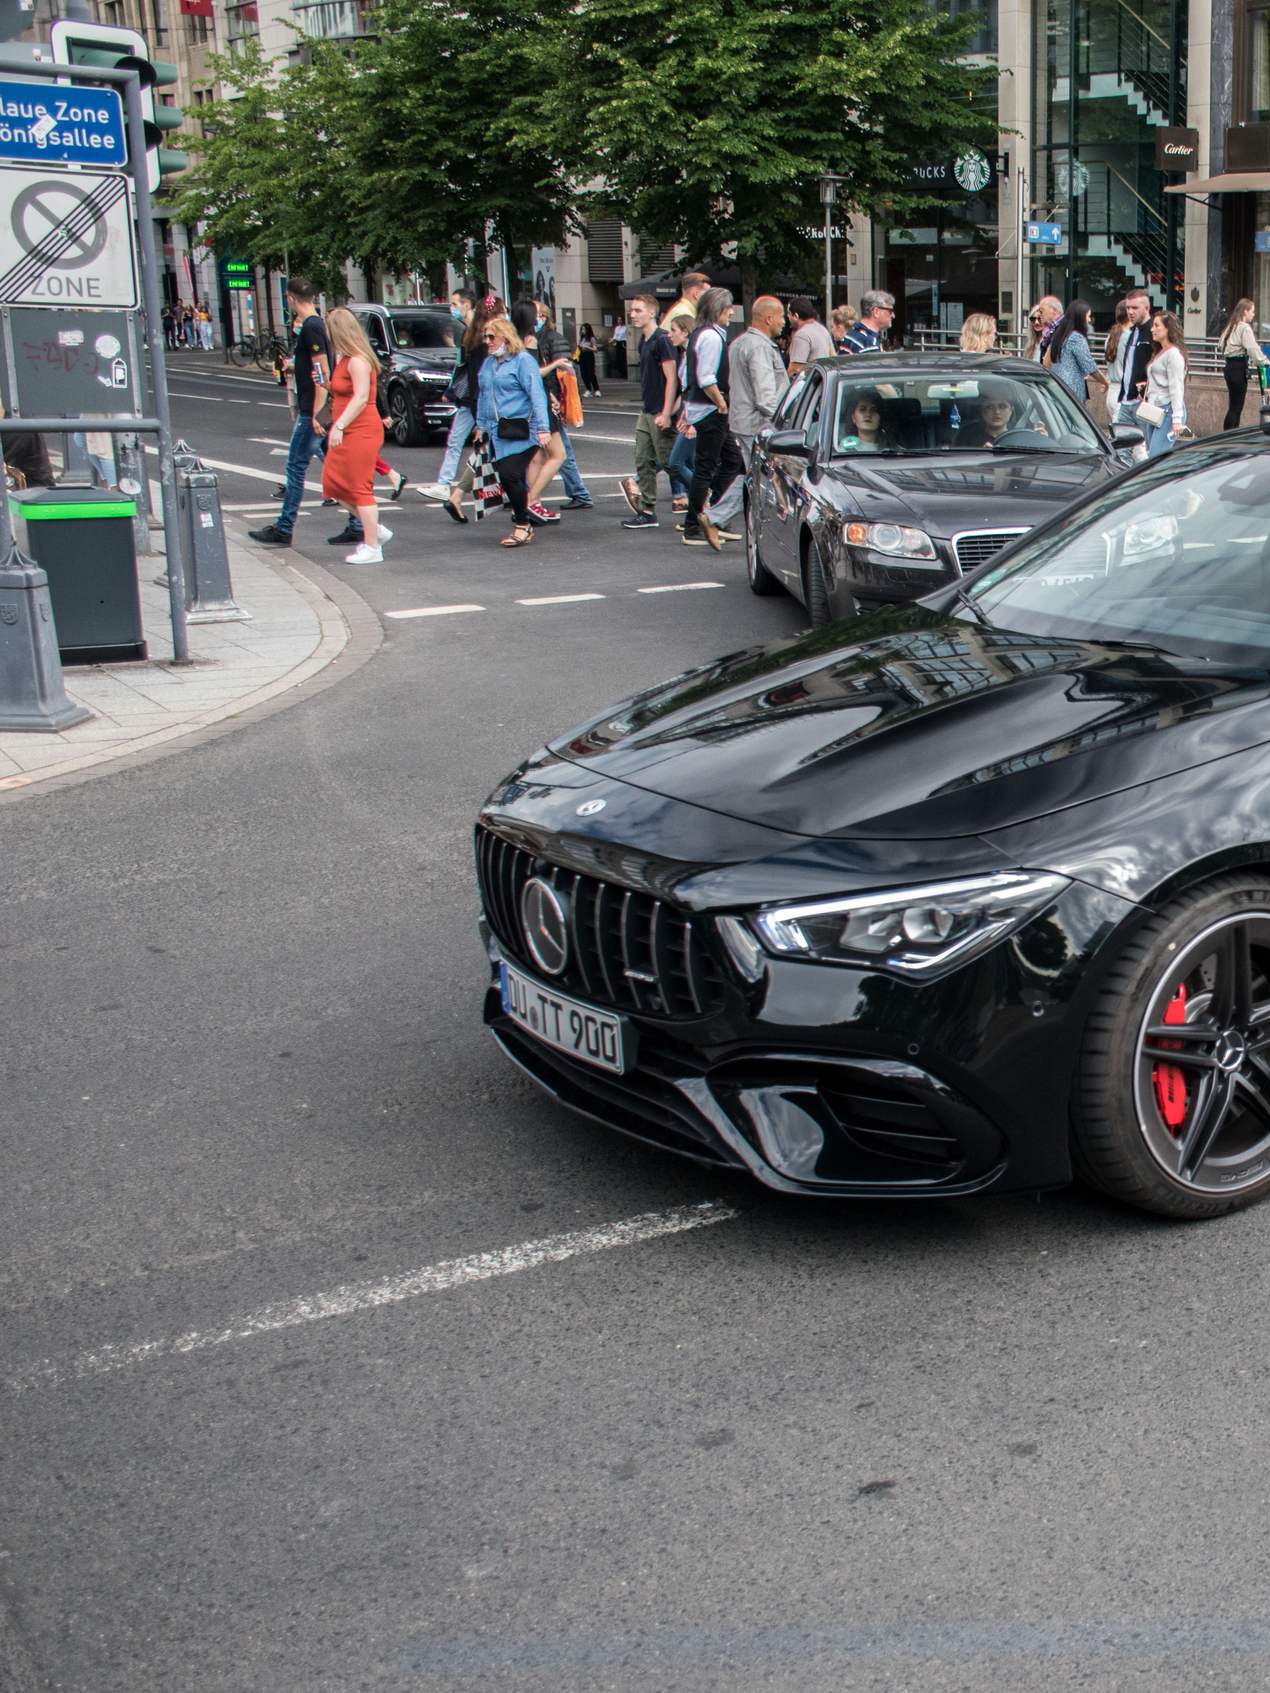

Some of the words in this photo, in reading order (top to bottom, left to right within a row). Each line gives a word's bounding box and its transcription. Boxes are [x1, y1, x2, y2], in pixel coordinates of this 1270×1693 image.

[0, 96, 48, 119] laue
[55, 101, 109, 124] Zone
[0, 122, 115, 149] önigsallee
[1164, 142, 1193, 155] Cartier
[31, 275, 102, 298] ZONE
[508, 973, 528, 1022] DU
[537, 992, 563, 1042] TT
[570, 1009, 617, 1064] 900
